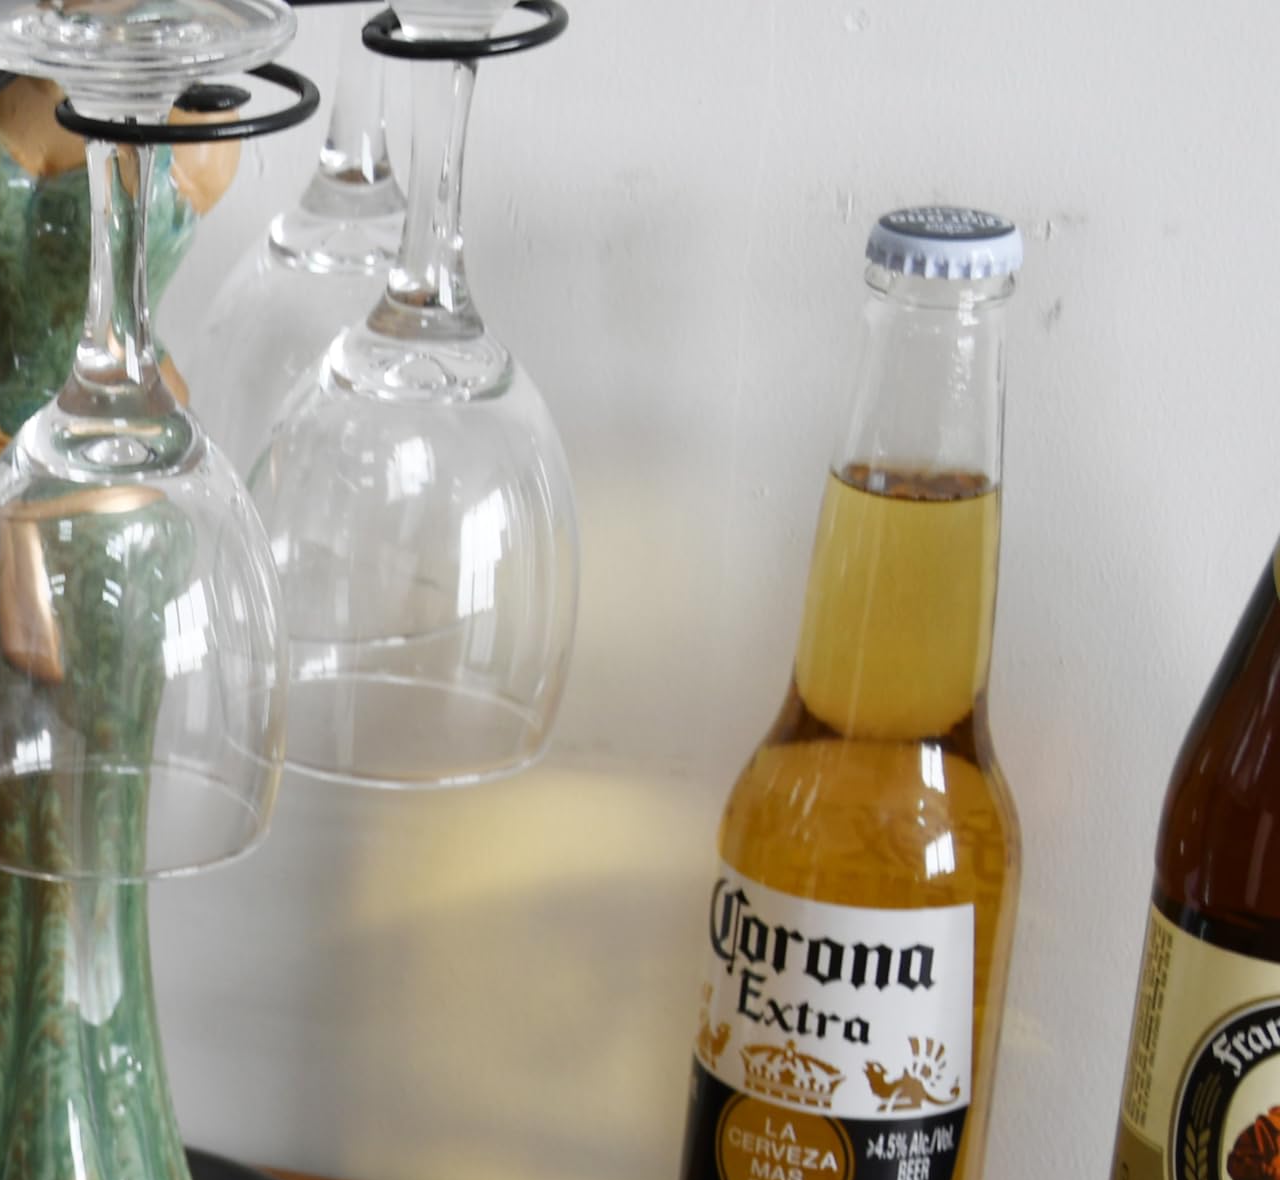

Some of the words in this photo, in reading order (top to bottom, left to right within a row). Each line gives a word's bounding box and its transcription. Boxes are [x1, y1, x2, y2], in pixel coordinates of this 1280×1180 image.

[710, 877, 936, 991] Corona
[736, 967, 871, 1045] Extra
[727, 1126, 838, 1172] CERVEZA
[766, 1117, 797, 1142] LA
